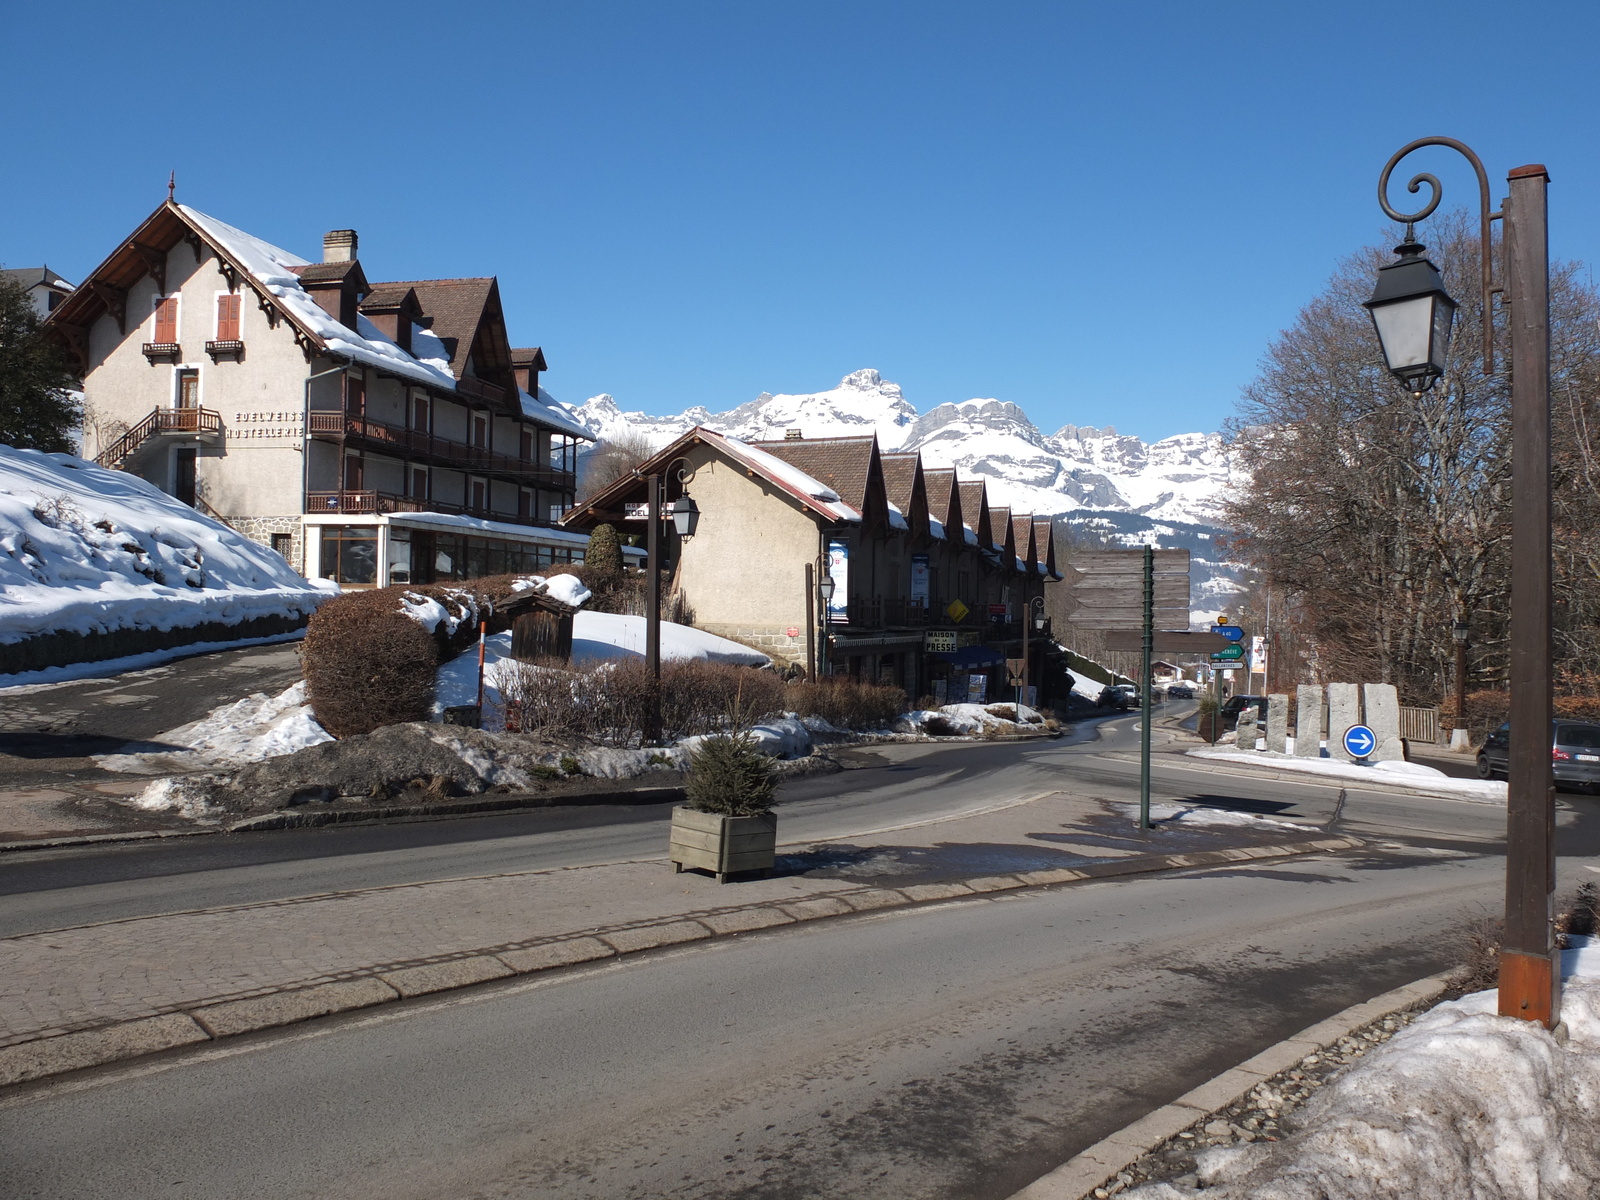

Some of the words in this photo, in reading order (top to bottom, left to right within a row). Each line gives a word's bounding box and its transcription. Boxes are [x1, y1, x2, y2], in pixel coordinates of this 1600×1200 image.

[235, 411, 304, 422] EDELWEISS
[225, 427, 304, 439] HOSTELLERIE
[926, 643, 956, 652] PRESSE
